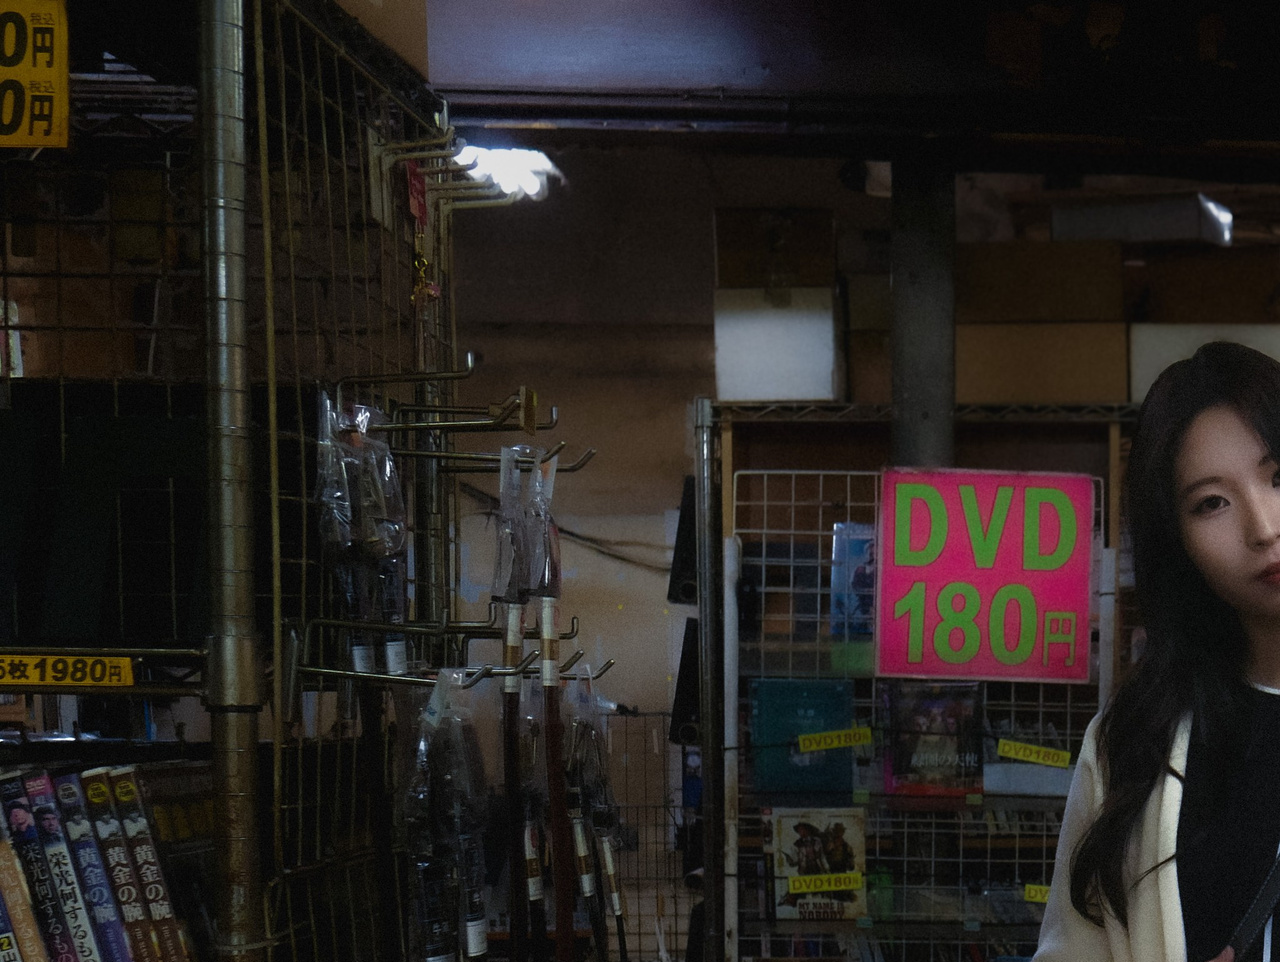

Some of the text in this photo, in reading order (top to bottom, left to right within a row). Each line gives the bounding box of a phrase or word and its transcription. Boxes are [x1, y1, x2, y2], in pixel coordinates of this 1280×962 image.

[894, 482, 1077, 571] DVD
[894, 581, 1077, 667] 180円
[77, 846, 118, 923] 黄金の腕
[105, 845, 145, 923] 黄金の腕
[133, 843, 173, 921] 黄金の腕
